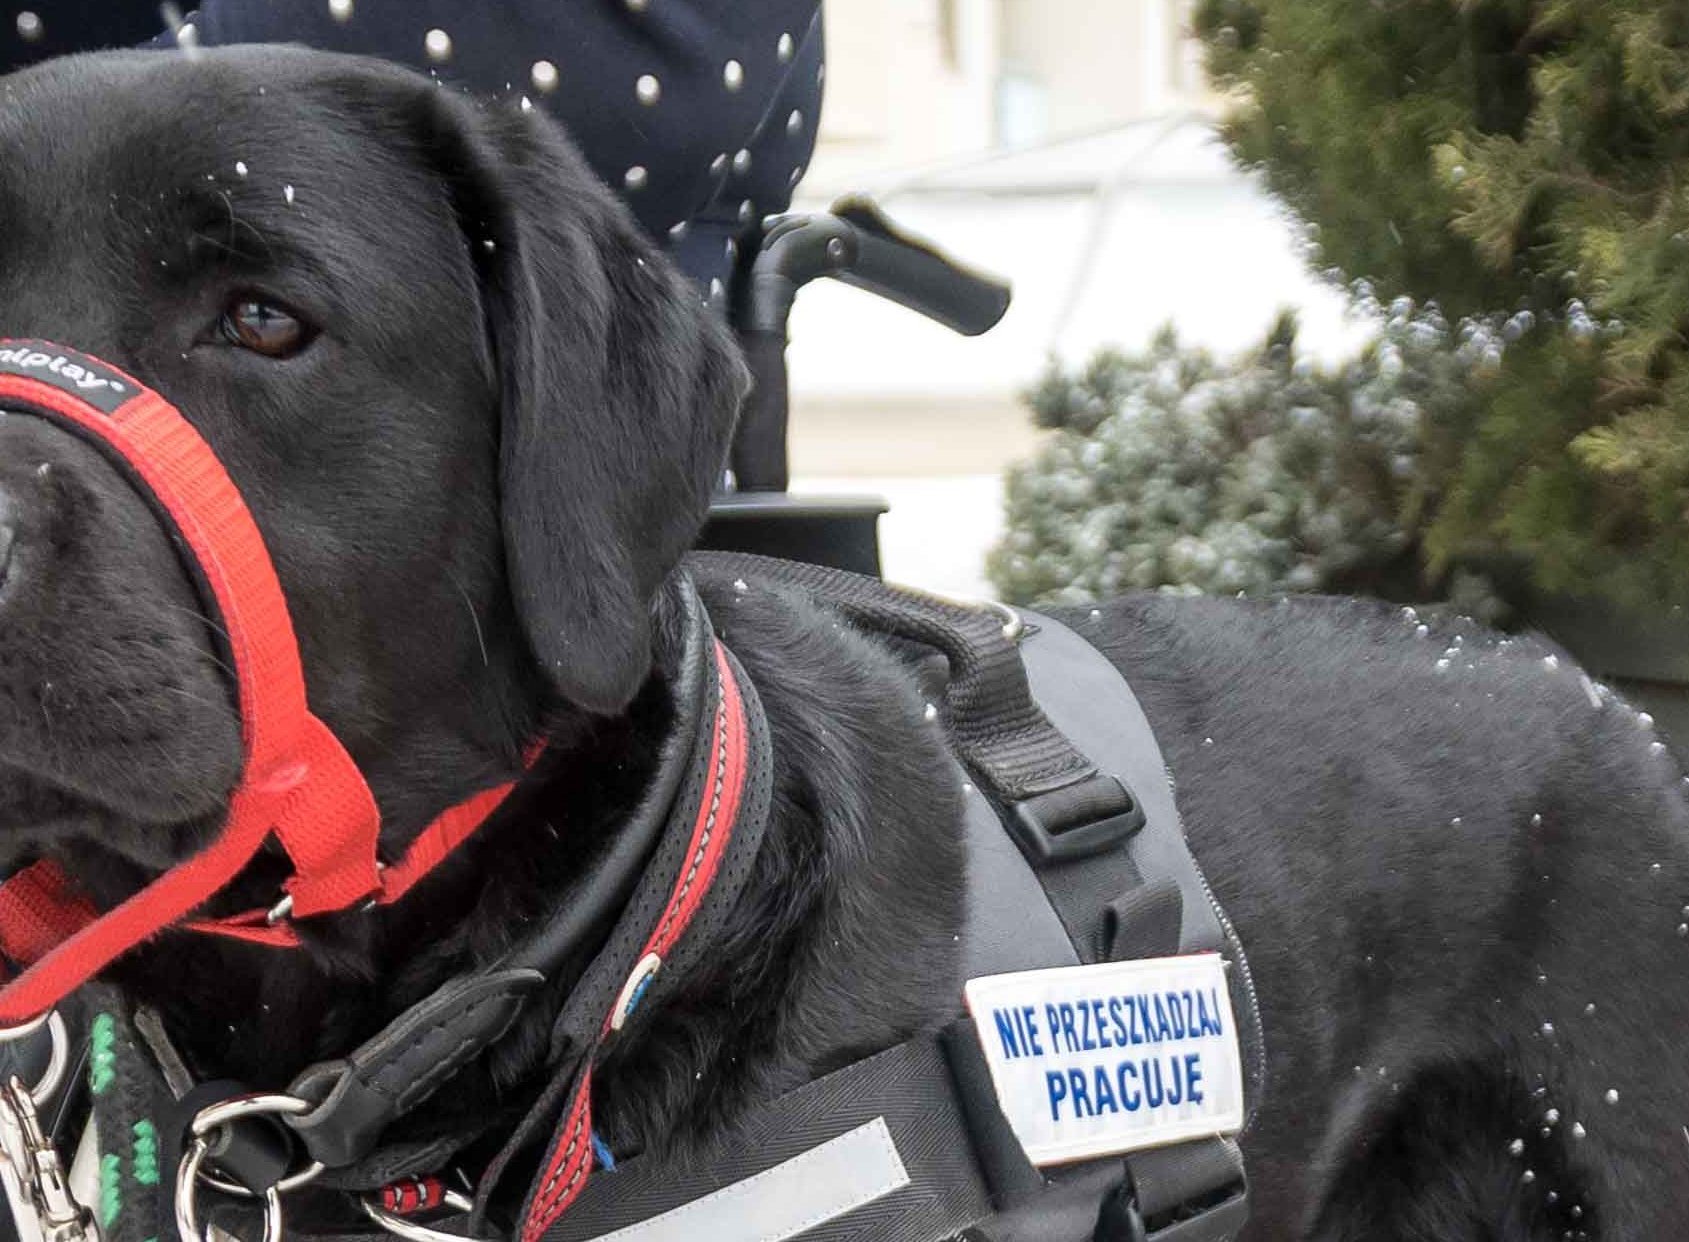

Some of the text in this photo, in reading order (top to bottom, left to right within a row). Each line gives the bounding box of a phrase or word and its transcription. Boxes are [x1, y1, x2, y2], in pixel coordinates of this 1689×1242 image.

[992, 986, 1223, 1059] NIE PRZESZKADZAJ
[1045, 1052, 1204, 1121] PRACUJĘ
